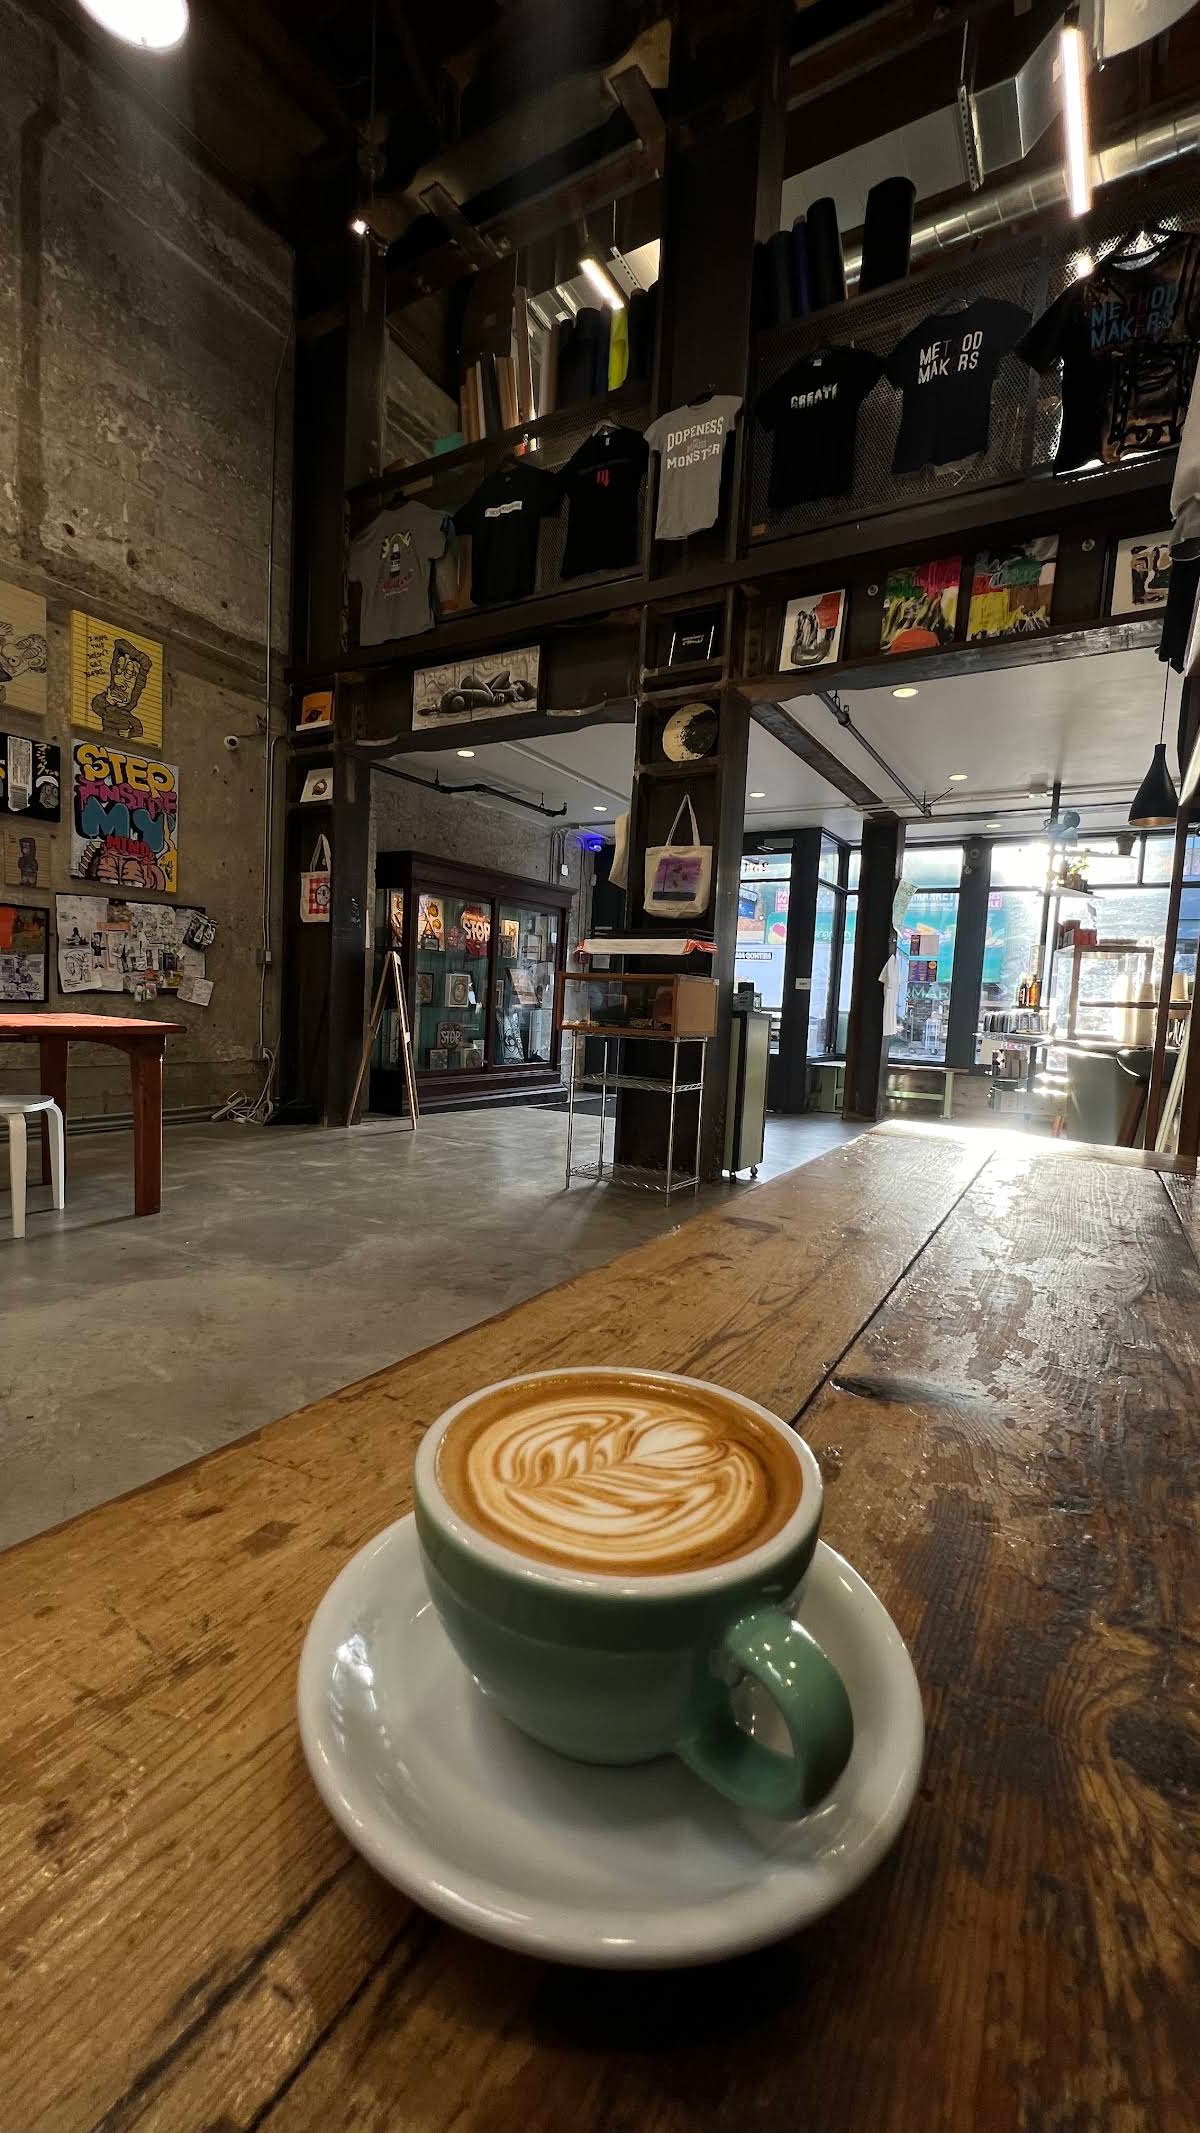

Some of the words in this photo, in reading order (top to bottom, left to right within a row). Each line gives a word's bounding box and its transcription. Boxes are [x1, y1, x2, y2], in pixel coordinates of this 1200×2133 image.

[920, 330, 983, 367] METOD
[918, 351, 980, 385] MAKRS
[667, 416, 725, 453] DOPENESS
[666, 443, 721, 470] MONSTER
[77, 743, 175, 799] STEP
[81, 796, 165, 854] MY
[462, 919, 491, 942] STOP
[441, 1030, 463, 1044] STOP
